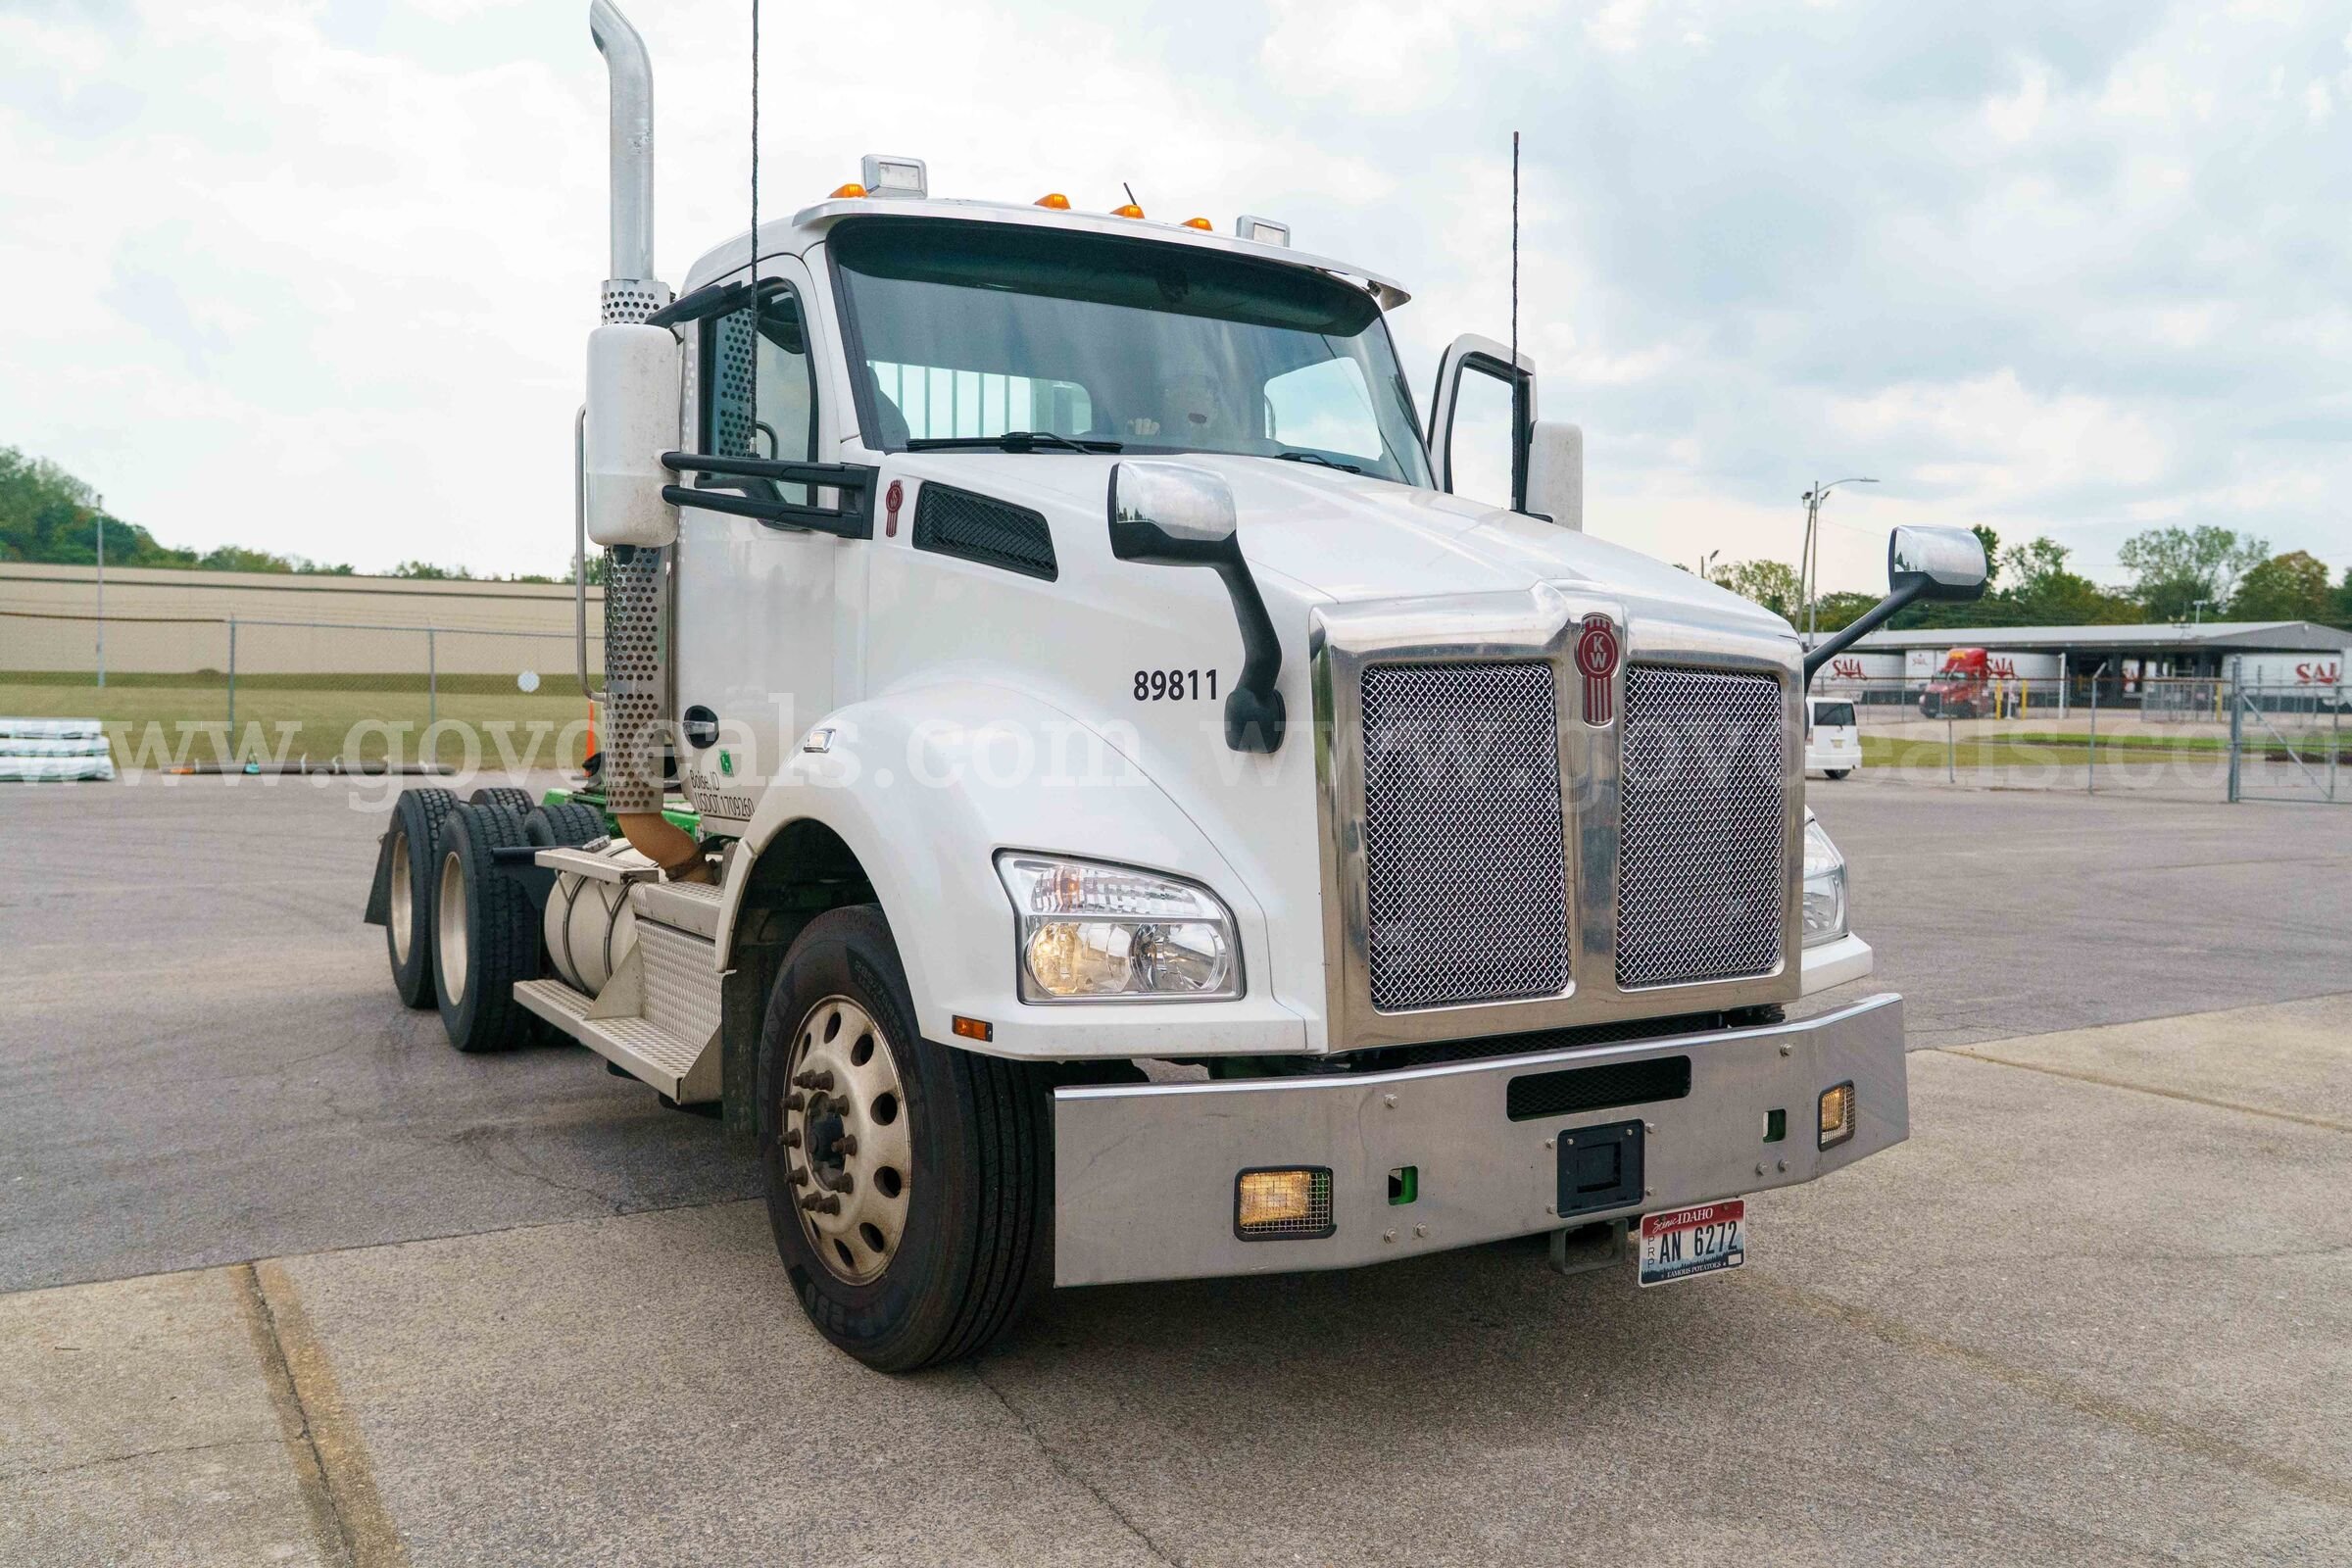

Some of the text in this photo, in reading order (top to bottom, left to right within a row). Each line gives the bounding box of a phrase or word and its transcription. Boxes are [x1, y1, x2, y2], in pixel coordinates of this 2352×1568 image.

[1590, 636, 1607, 668] KW
[1832, 659, 1866, 678] SAIA
[1133, 668, 1217, 702] 89811
[711, 771, 720, 791] ID
[695, 793, 756, 817] USDOT 1709260
[1677, 1207, 1713, 1225] IDAHO
[1659, 1220, 1738, 1264] AN 6272
[1667, 1261, 1722, 1278] FAMOUS POTATOES
